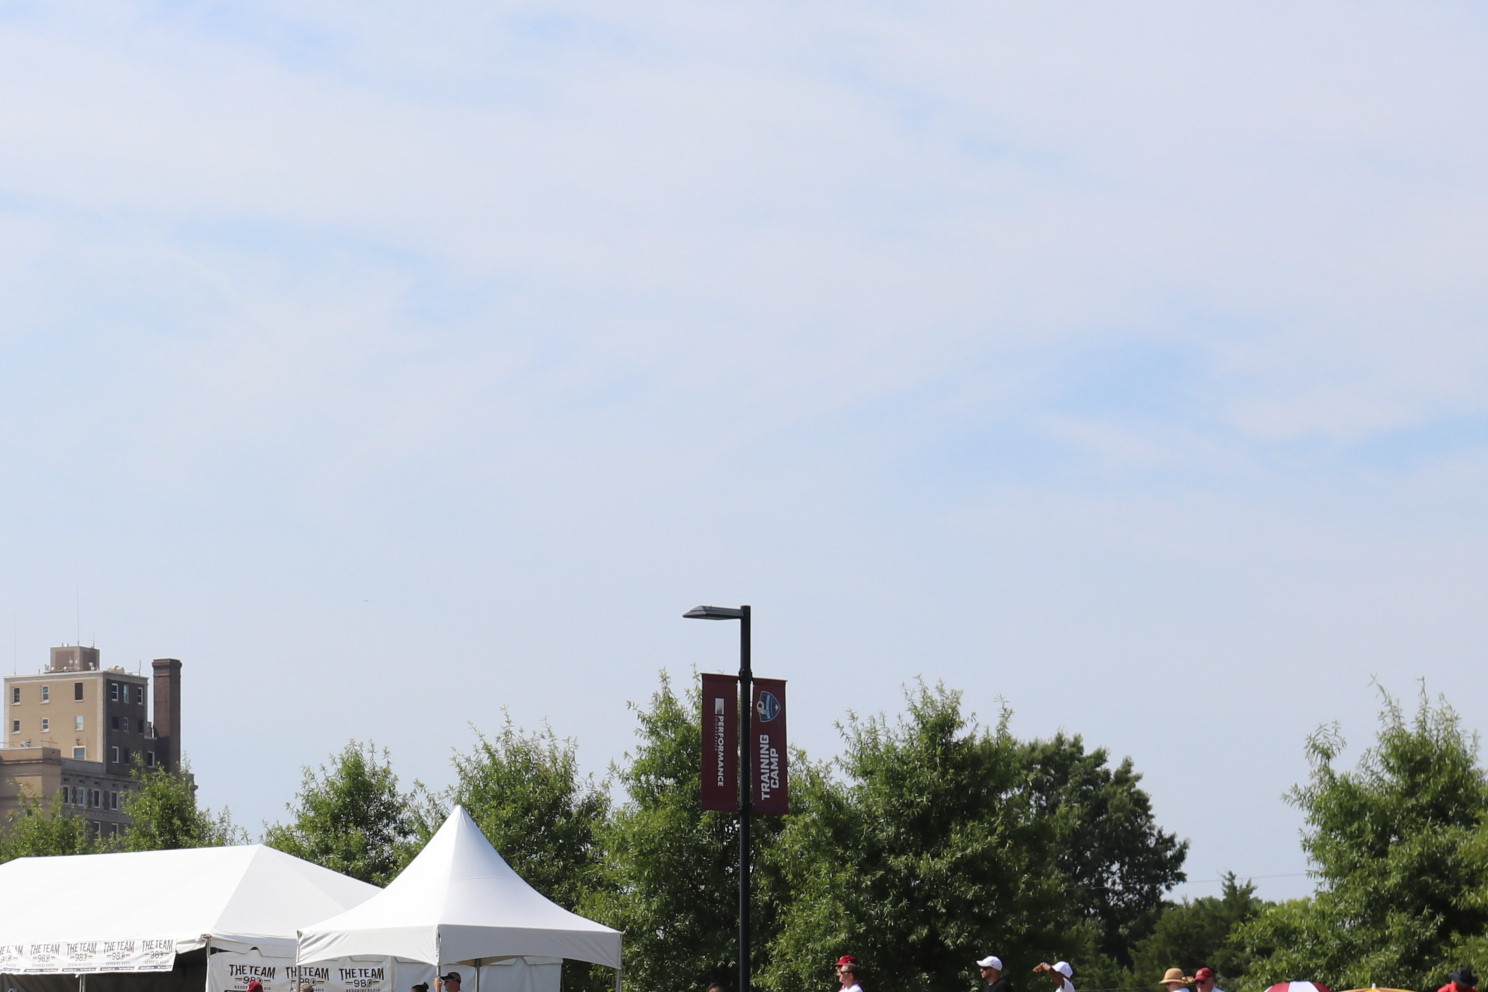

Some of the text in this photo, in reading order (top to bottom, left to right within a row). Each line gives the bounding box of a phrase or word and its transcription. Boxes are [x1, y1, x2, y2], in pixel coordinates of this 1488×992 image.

[760, 734, 770, 800] TRAINING
[770, 748, 779, 788] CAMP
[30, 944, 60, 956] THE TEAM
[67, 942, 97, 955] THE TEAM
[104, 941, 135, 954] THE TEAM
[142, 940, 173, 952] THE TEAM
[229, 964, 275, 979] THE TEAM
[286, 967, 329, 980] TH TEAM
[339, 967, 384, 980] THE TEAM
